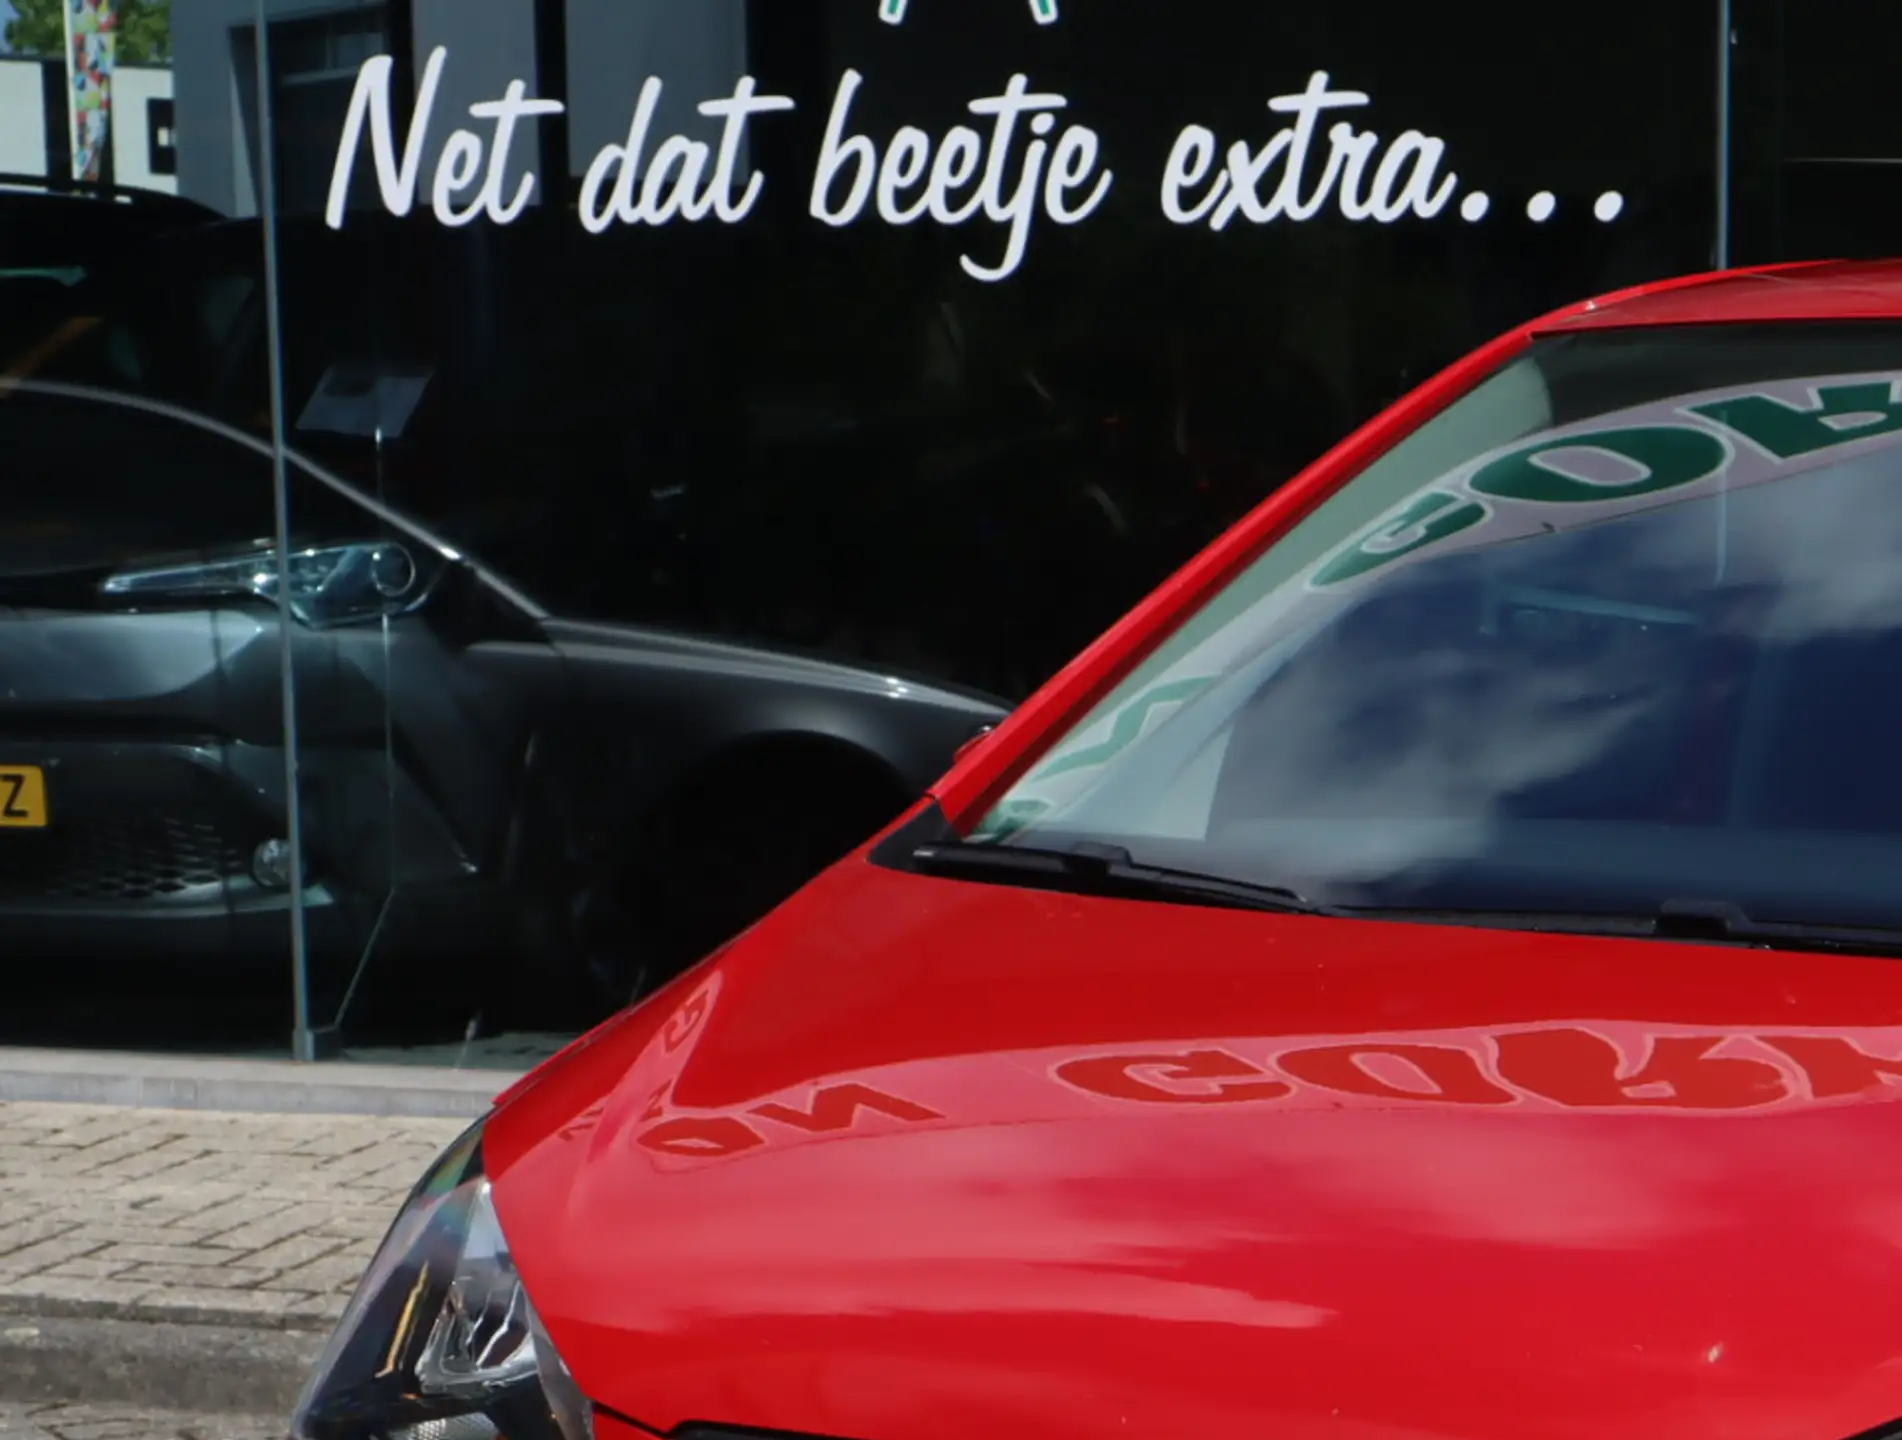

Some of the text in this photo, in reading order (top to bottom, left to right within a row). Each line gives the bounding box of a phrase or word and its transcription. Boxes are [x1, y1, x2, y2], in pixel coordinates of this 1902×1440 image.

[327, 46, 564, 229] Net
[580, 76, 793, 232] dat
[811, 70, 1112, 281] beetje
